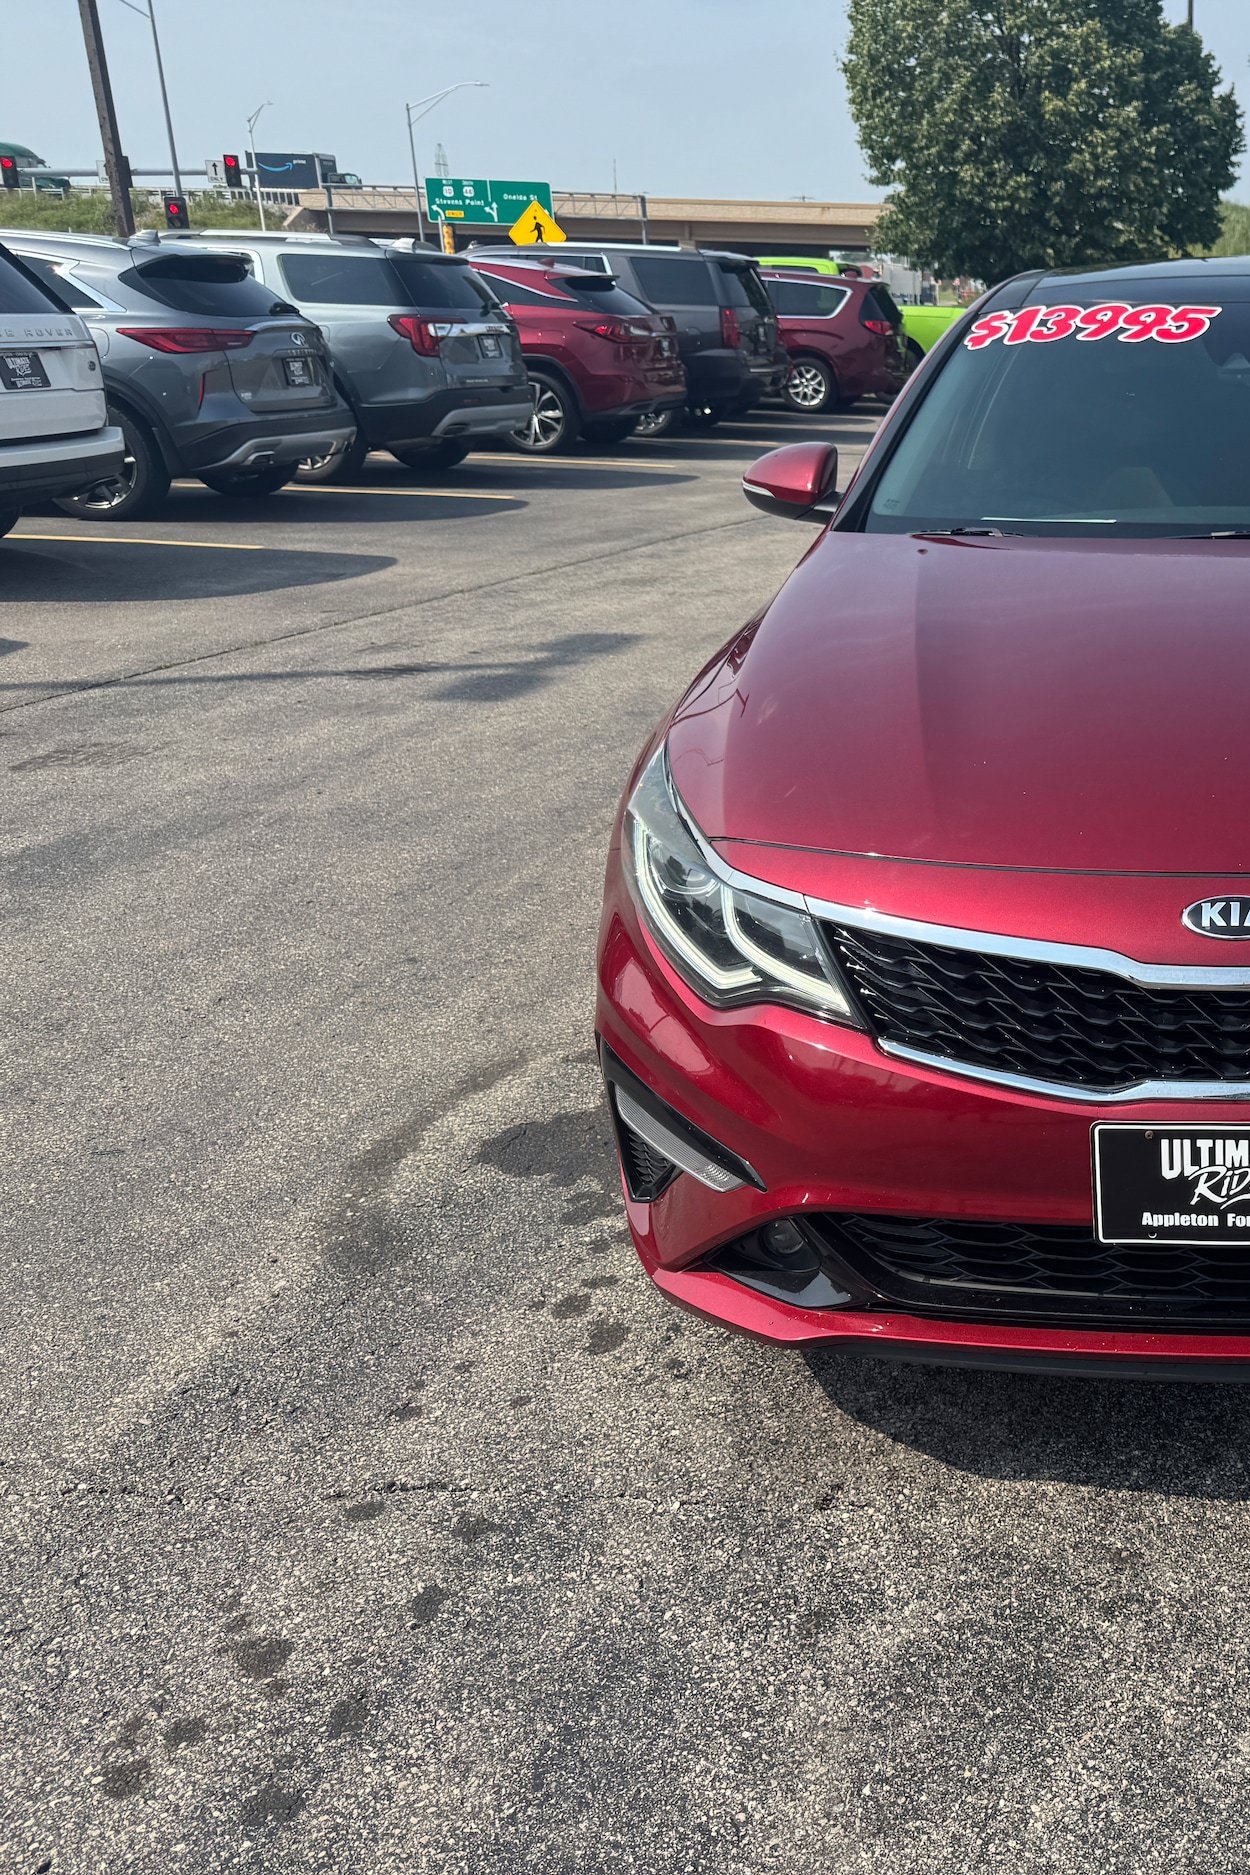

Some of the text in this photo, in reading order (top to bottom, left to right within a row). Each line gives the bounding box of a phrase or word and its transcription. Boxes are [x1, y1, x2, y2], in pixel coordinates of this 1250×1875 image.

[435, 198, 463, 206] Stevens
[503, 193, 528, 201] Oneida
[23, 327, 74, 337] ROVER
[964, 304, 1222, 350] $13995
[1141, 1211, 1219, 1228] Appleton
